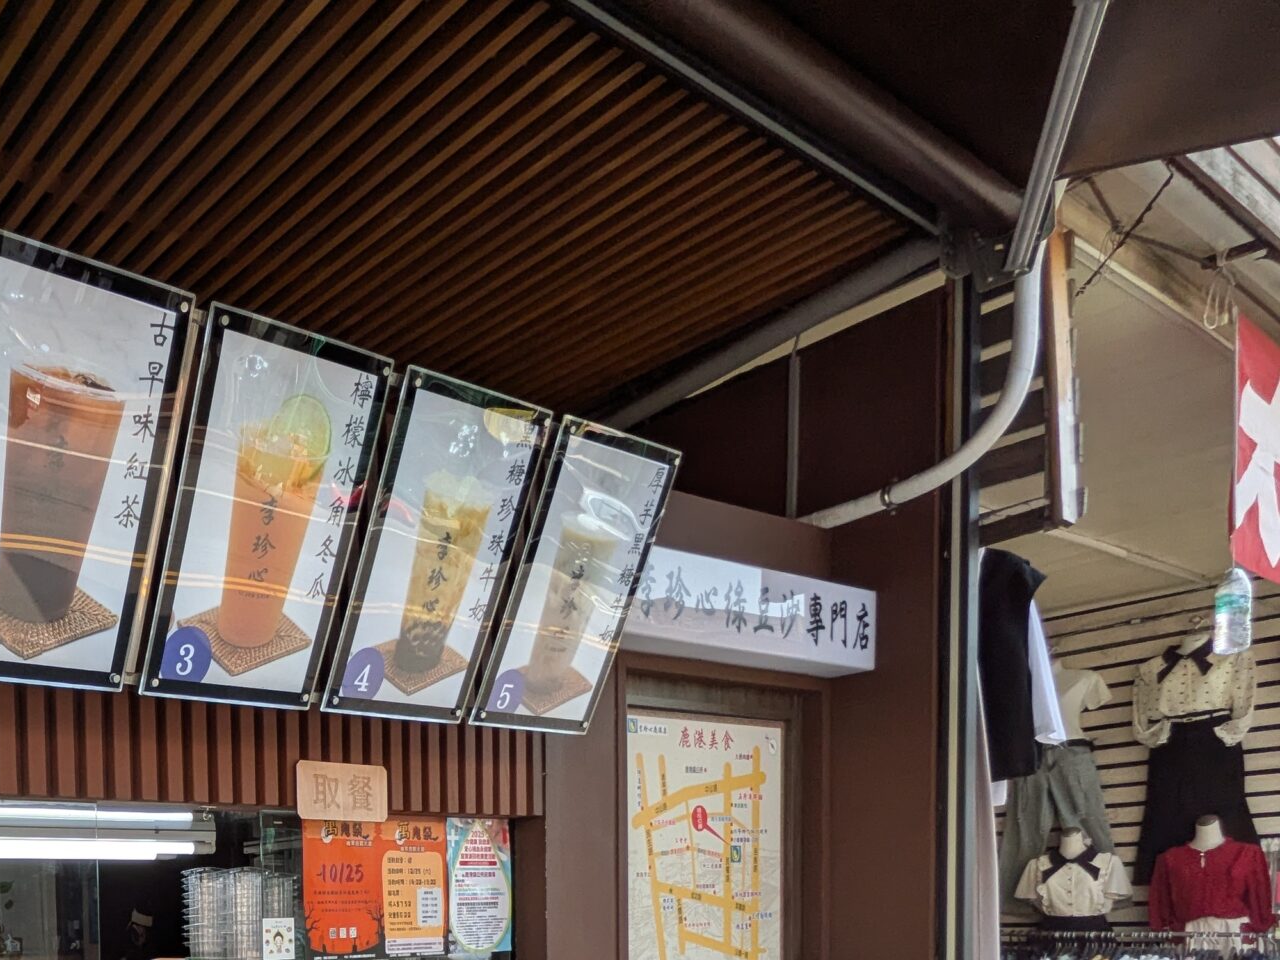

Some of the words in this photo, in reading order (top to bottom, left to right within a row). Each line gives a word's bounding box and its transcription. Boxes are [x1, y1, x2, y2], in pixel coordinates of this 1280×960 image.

[114, 312, 174, 528] 古早味紅茶
[306, 374, 373, 599] 檸檬冰角冬瓜
[468, 424, 539, 623] 黑糖珍珠牛奶
[247, 495, 276, 584] 李珍心
[422, 532, 451, 614] 李珍心
[598, 467, 668, 645] 厚芋黑糖牛奶
[638, 563, 871, 650] 李珍心綠豆沙專門店
[175, 643, 195, 676] 3
[353, 664, 372, 692] 4
[496, 683, 514, 710] 5
[679, 726, 735, 751] 鹿港美食
[312, 773, 374, 812] 取餐
